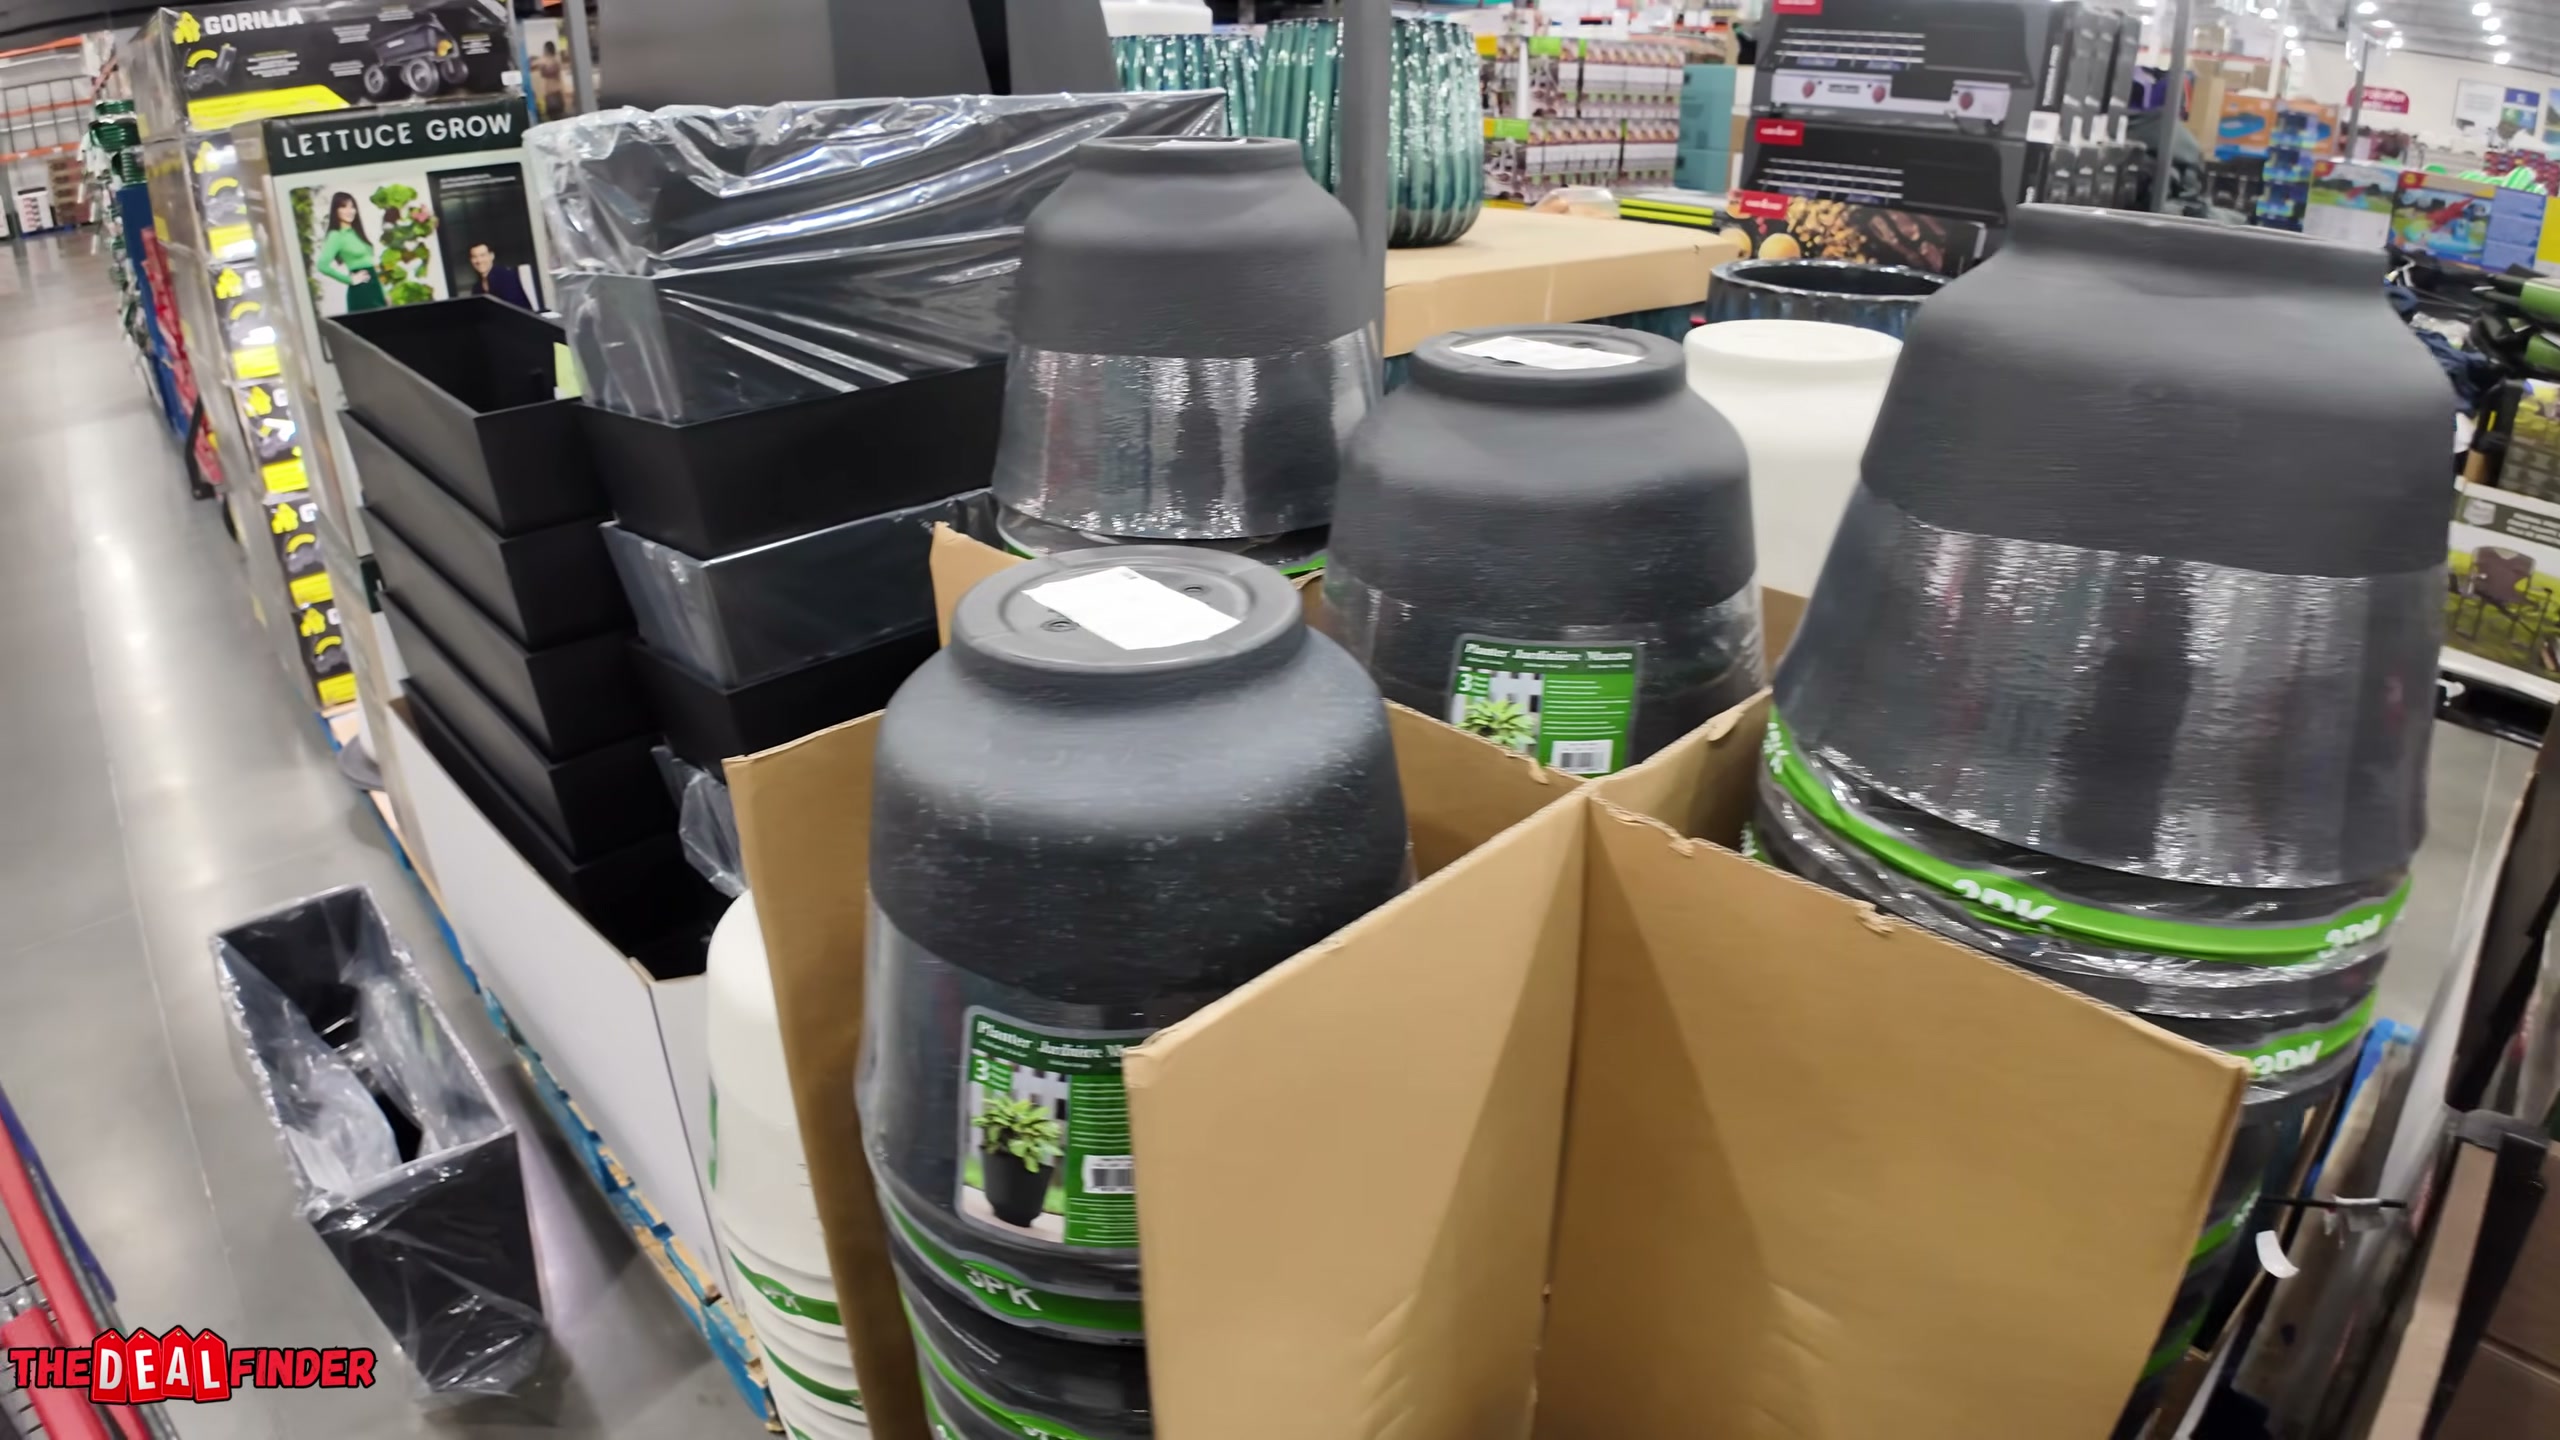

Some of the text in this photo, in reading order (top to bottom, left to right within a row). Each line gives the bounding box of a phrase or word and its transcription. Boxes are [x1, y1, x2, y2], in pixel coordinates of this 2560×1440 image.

[203, 7, 305, 35] GORILLA
[282, 112, 512, 159] LETTUCE GROW
[1458, 673, 1473, 692] 3
[976, 1020, 1034, 1049] Planter
[974, 1058, 991, 1082] 3
